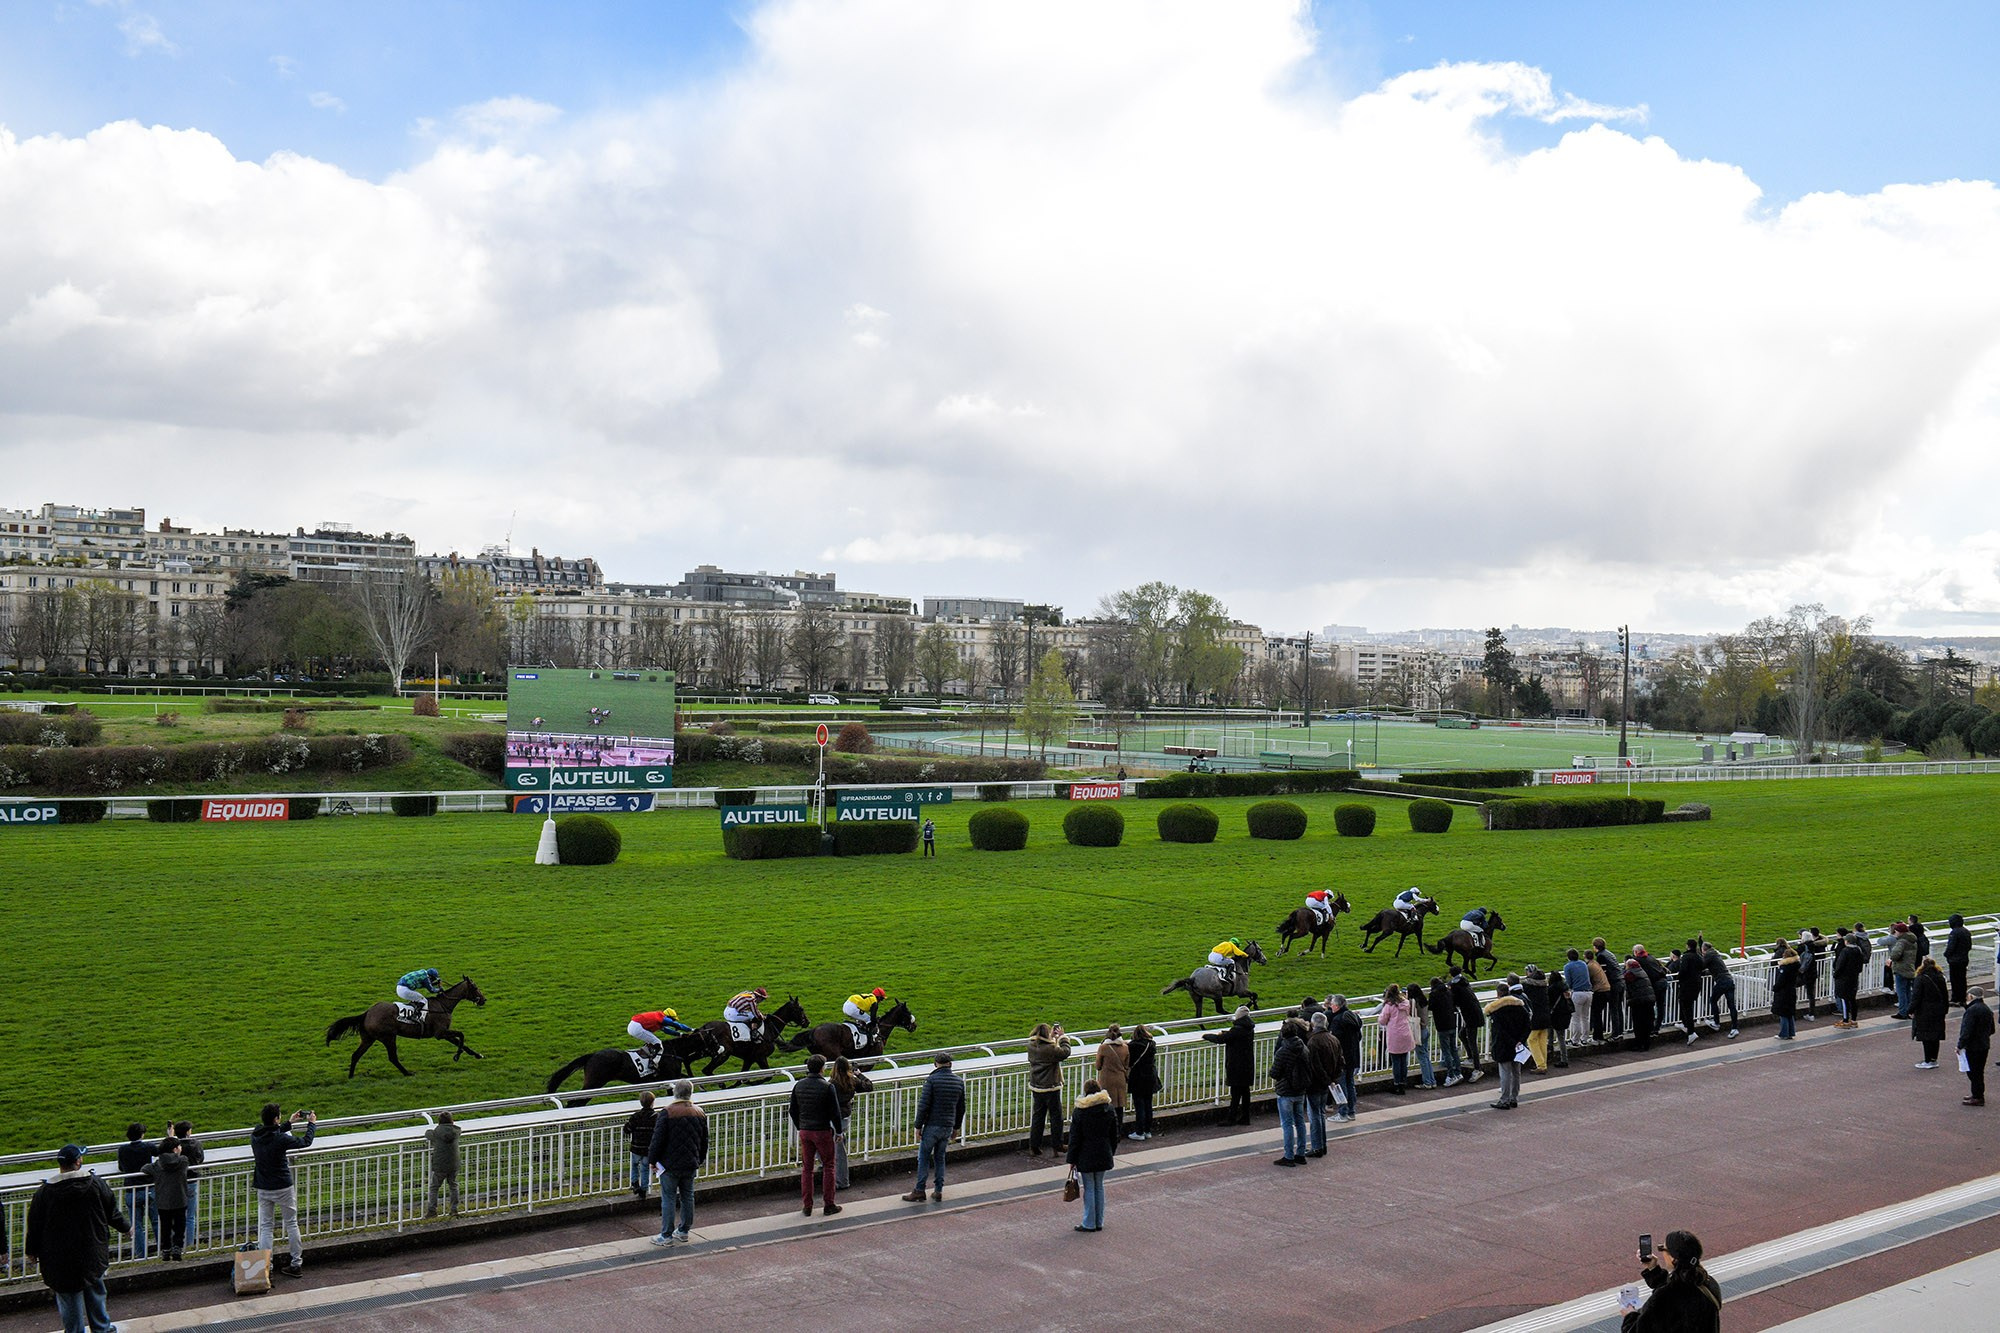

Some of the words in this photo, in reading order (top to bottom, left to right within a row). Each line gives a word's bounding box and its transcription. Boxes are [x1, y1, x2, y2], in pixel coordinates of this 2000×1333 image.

[552, 771, 635, 785] AUTEUIL
[1072, 785, 1119, 800] EQUIDIA
[555, 795, 617, 807] AFASEC
[206, 802, 285, 820] EQUIDIA
[724, 810, 805, 824] AUTEUIL
[840, 808, 918, 821] AUTEUIL
[732, 1025, 740, 1039] 8
[854, 1031, 861, 1045] 2
[635, 1058, 644, 1072] 5
